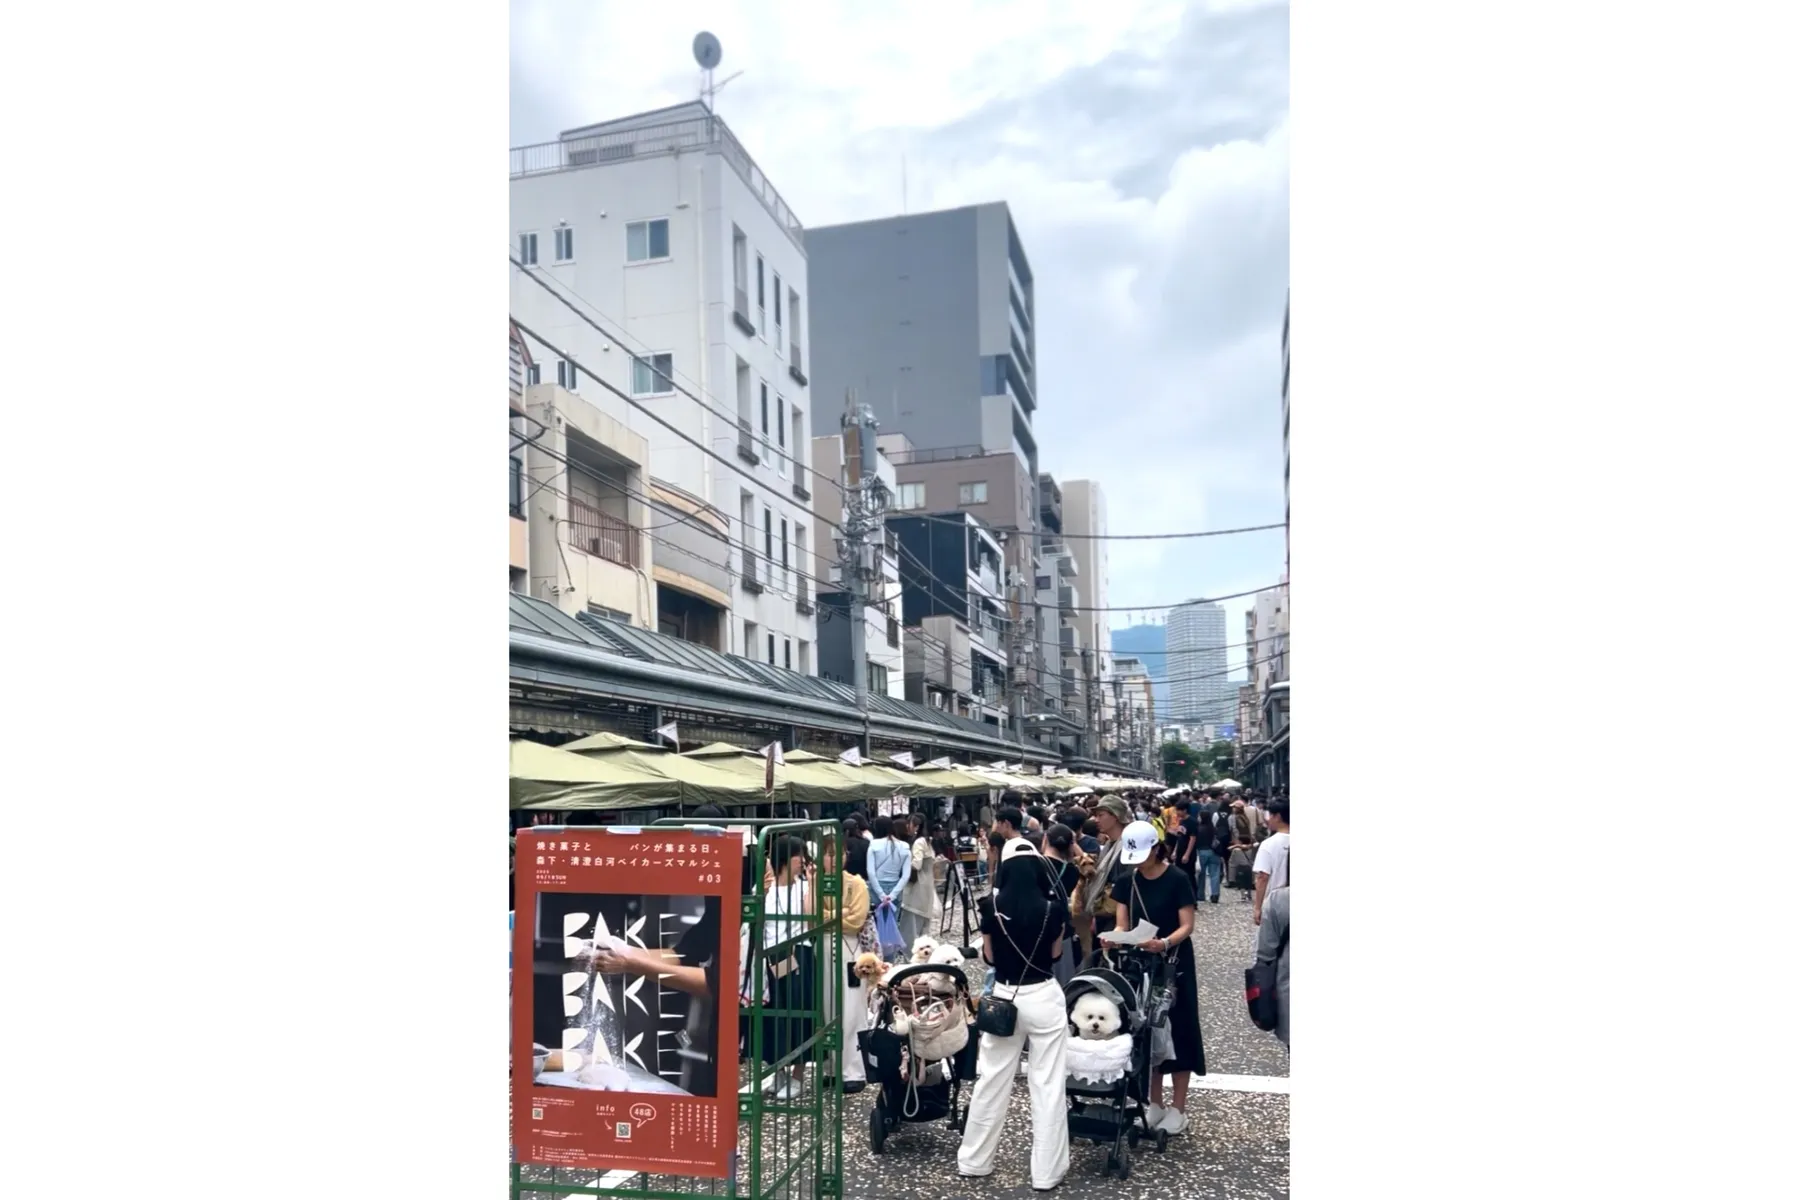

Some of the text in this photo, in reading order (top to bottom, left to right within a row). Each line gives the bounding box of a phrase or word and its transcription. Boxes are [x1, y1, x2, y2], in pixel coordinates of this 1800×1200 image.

[536, 841, 720, 855] 焼き菓子と パンが集まる日。
[536, 856, 722, 868] 森下・清澄白河ベイカーズマルシェ
[698, 874, 722, 884] #03
[562, 911, 686, 959] BAKE
[562, 971, 685, 1018] BAKE
[562, 1027, 685, 1075] BAKE
[596, 1104, 615, 1113] info
